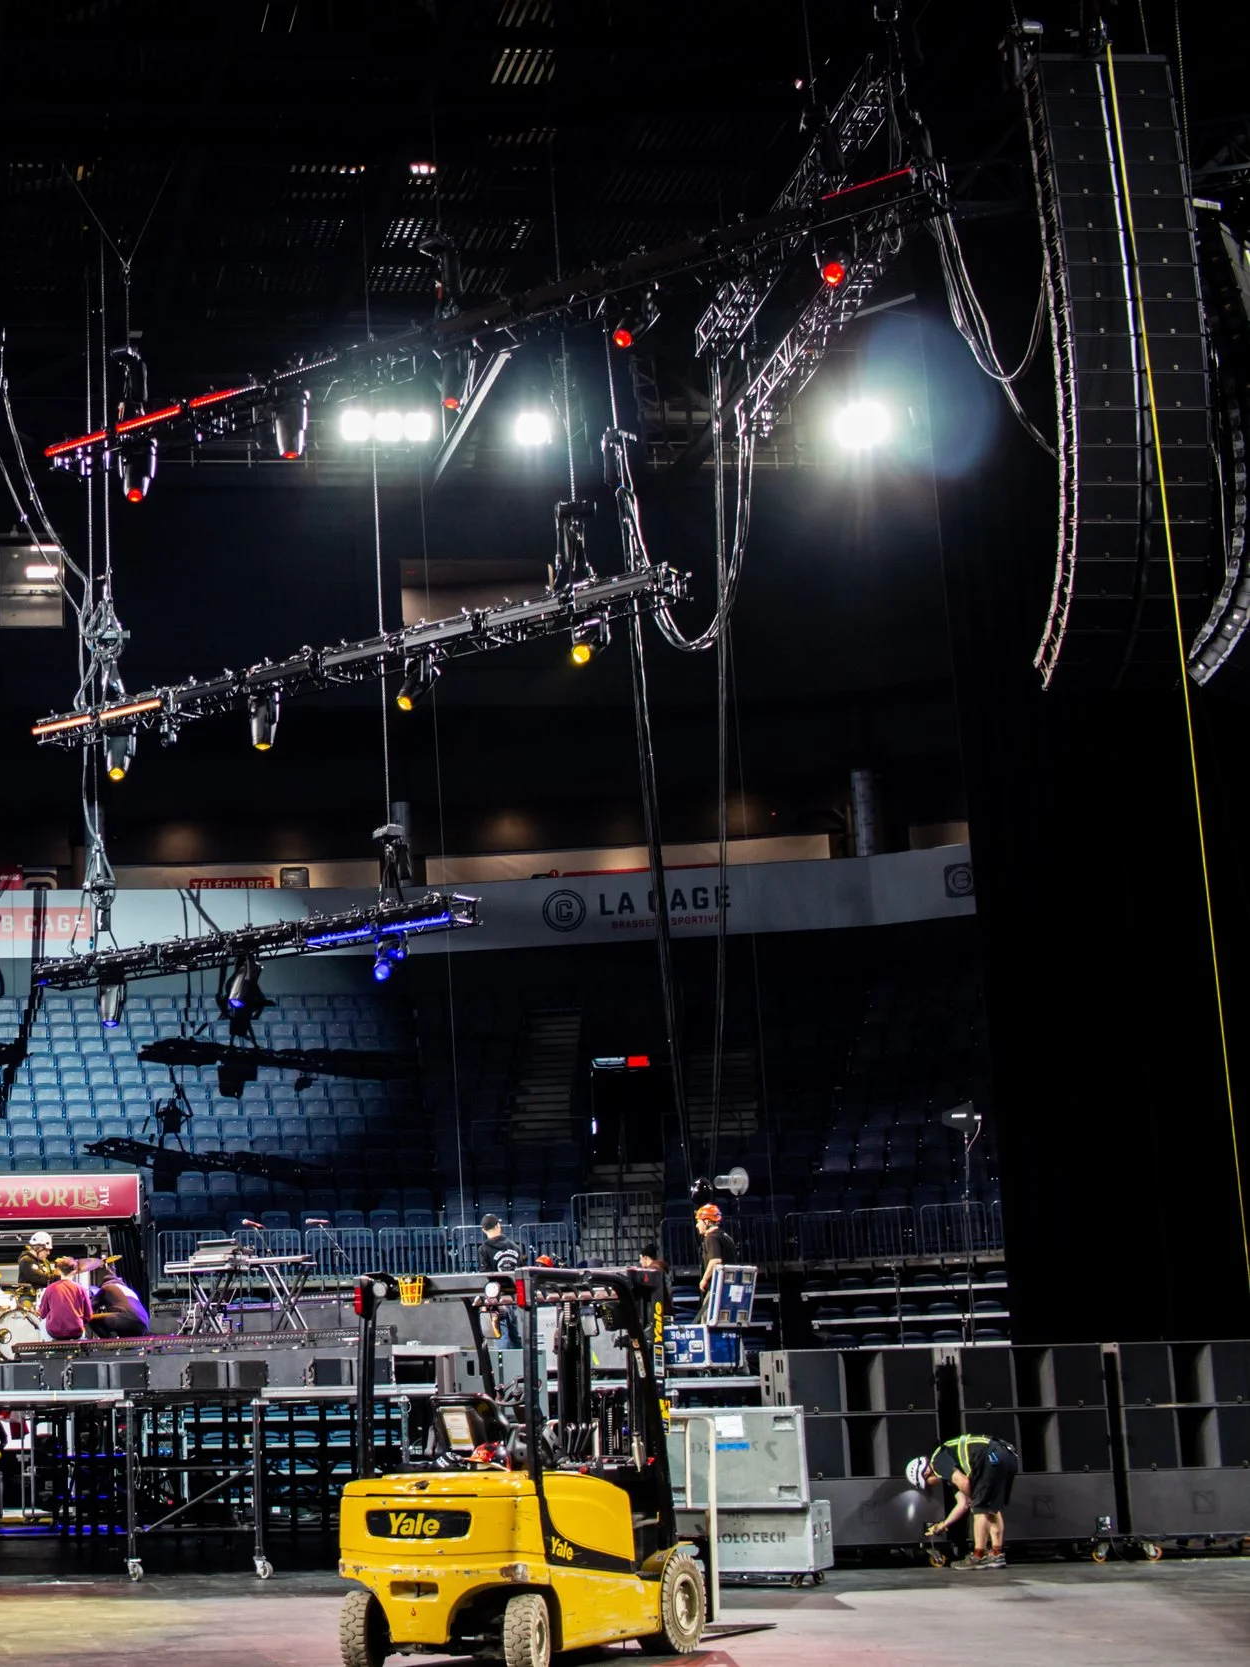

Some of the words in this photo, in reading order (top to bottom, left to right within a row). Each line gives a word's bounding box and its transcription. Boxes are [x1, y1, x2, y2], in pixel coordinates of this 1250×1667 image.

[599, 892, 634, 915] LA
[99, 1185, 110, 1206] ALE
[653, 1301, 663, 1344] Yale
[389, 1512, 440, 1536] Yale
[550, 1536, 574, 1561] Yale
